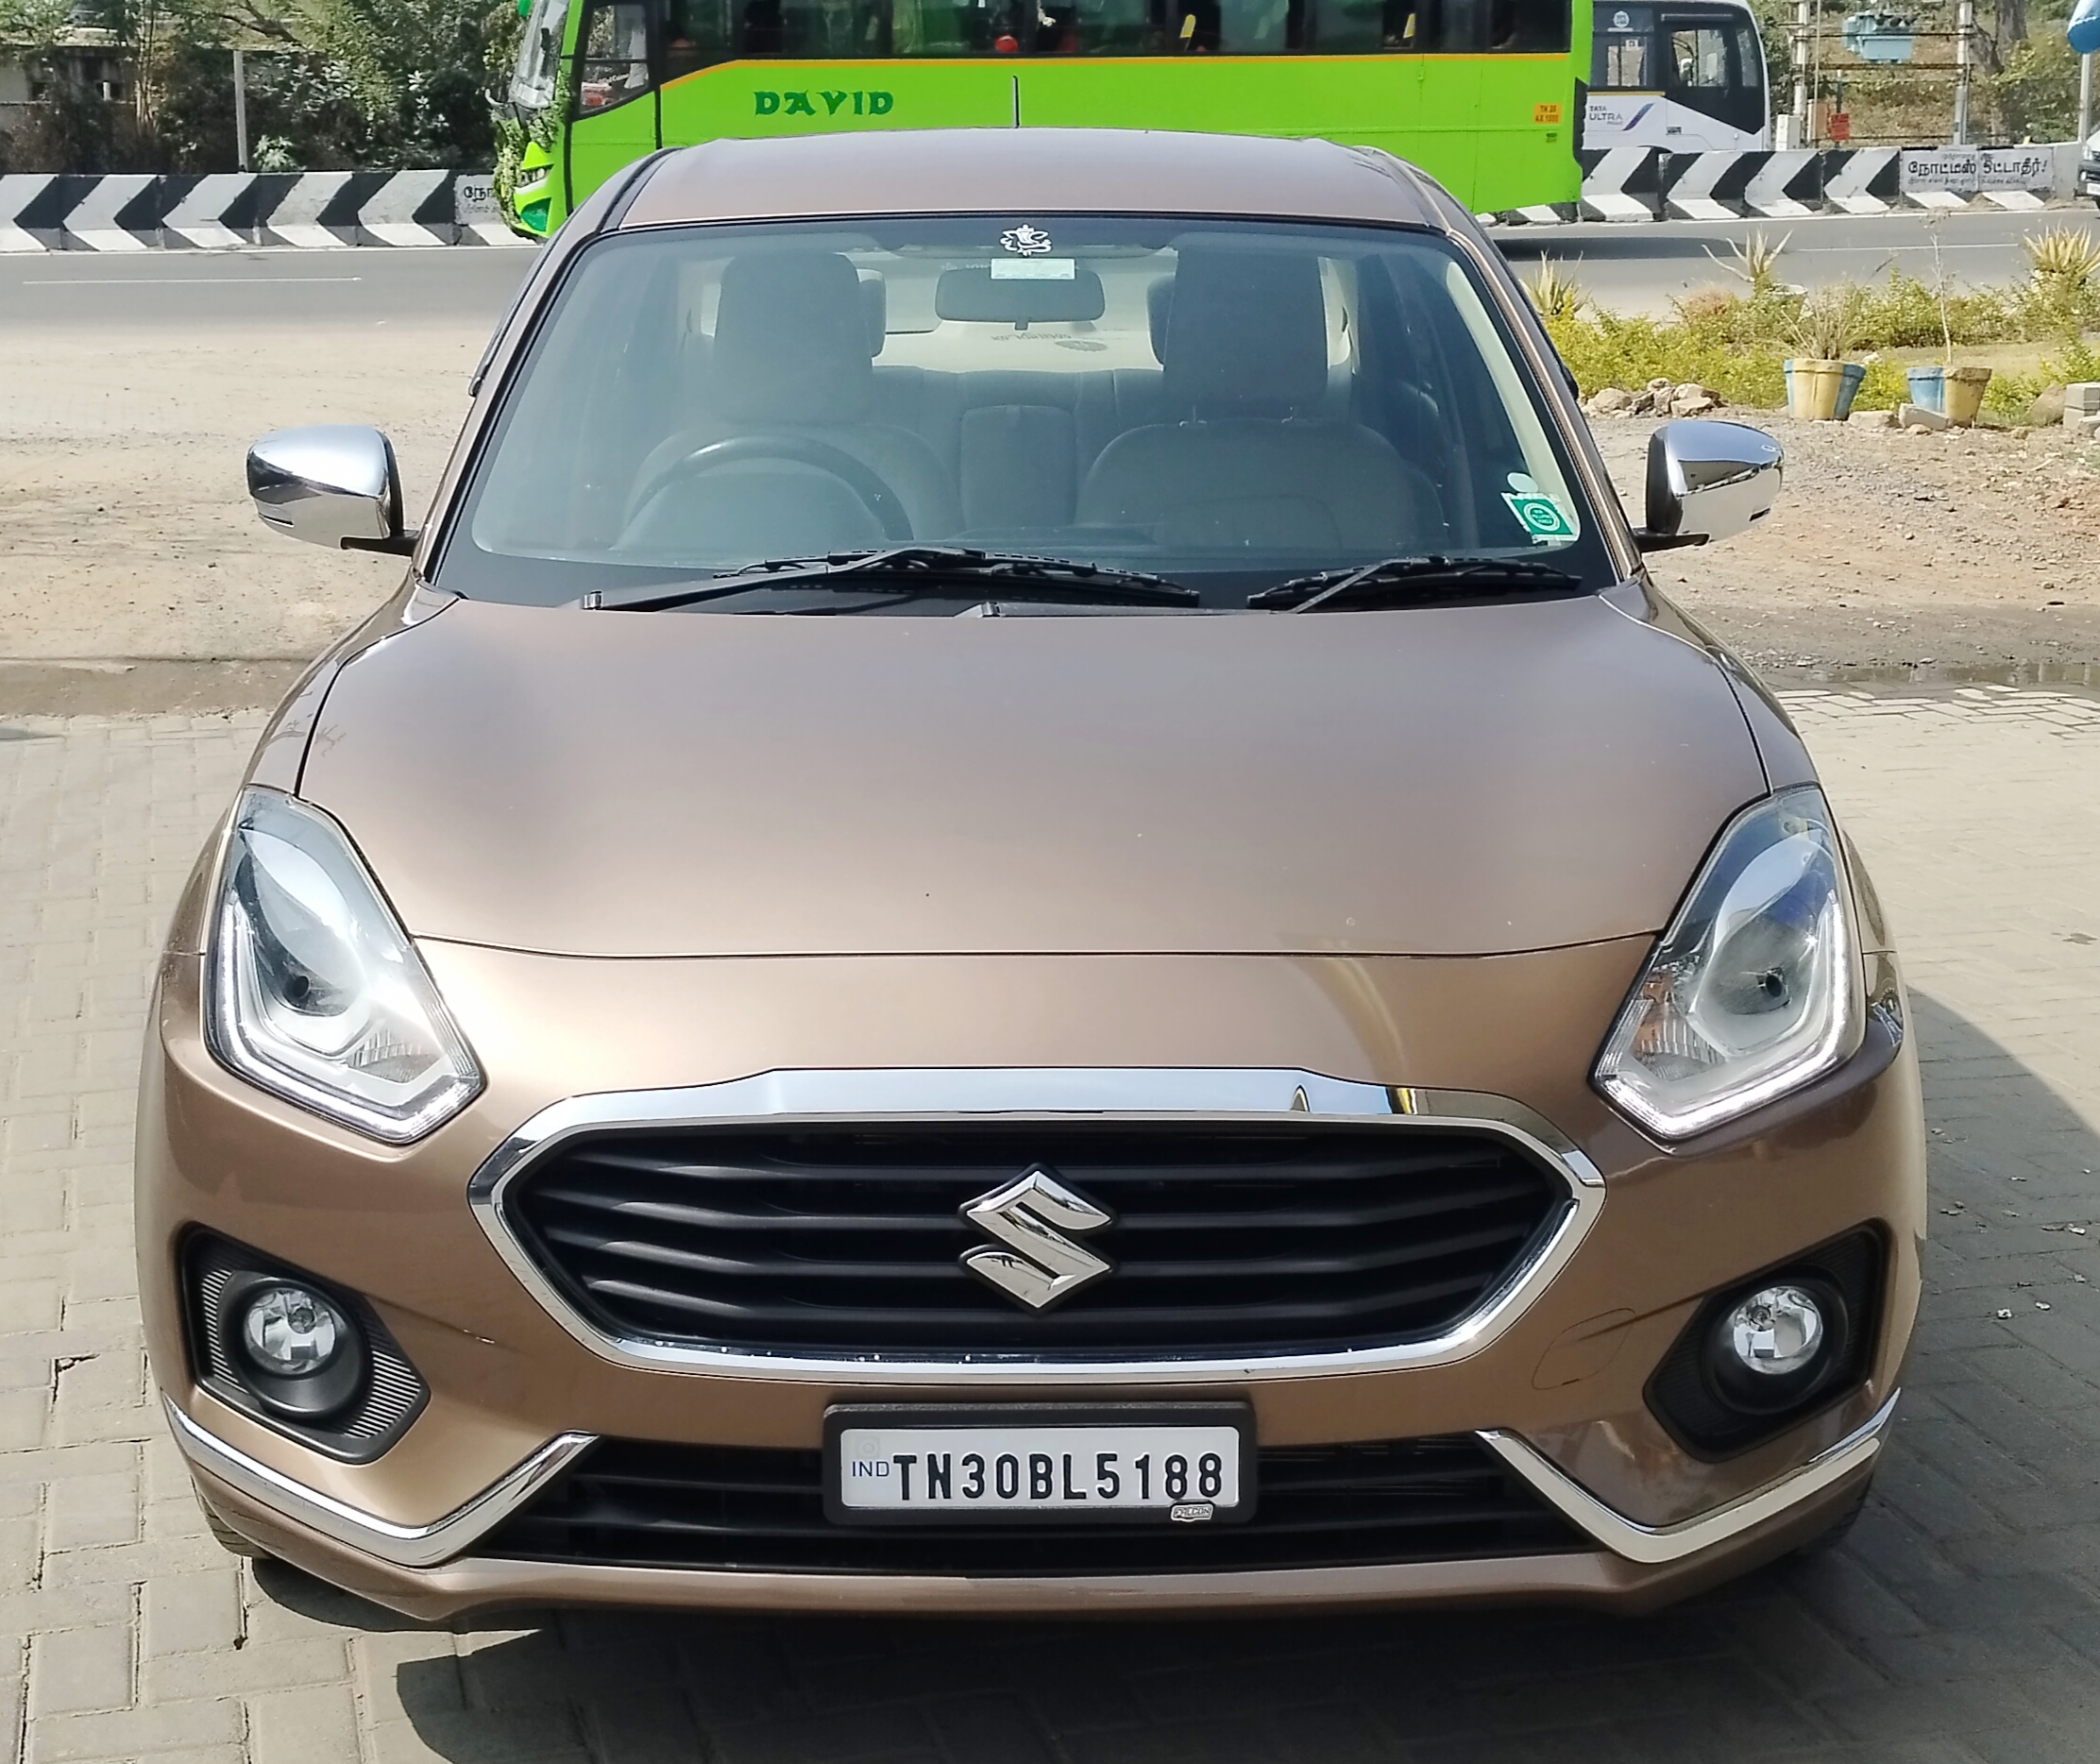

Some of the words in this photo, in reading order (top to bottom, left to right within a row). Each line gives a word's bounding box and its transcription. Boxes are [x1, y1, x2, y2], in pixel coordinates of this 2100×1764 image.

[754, 91, 894, 115] DAVID
[1589, 112, 1623, 121] ULTRA
[852, 1460, 889, 1478] IND
[893, 1452, 1223, 1501] TN30BL5188
